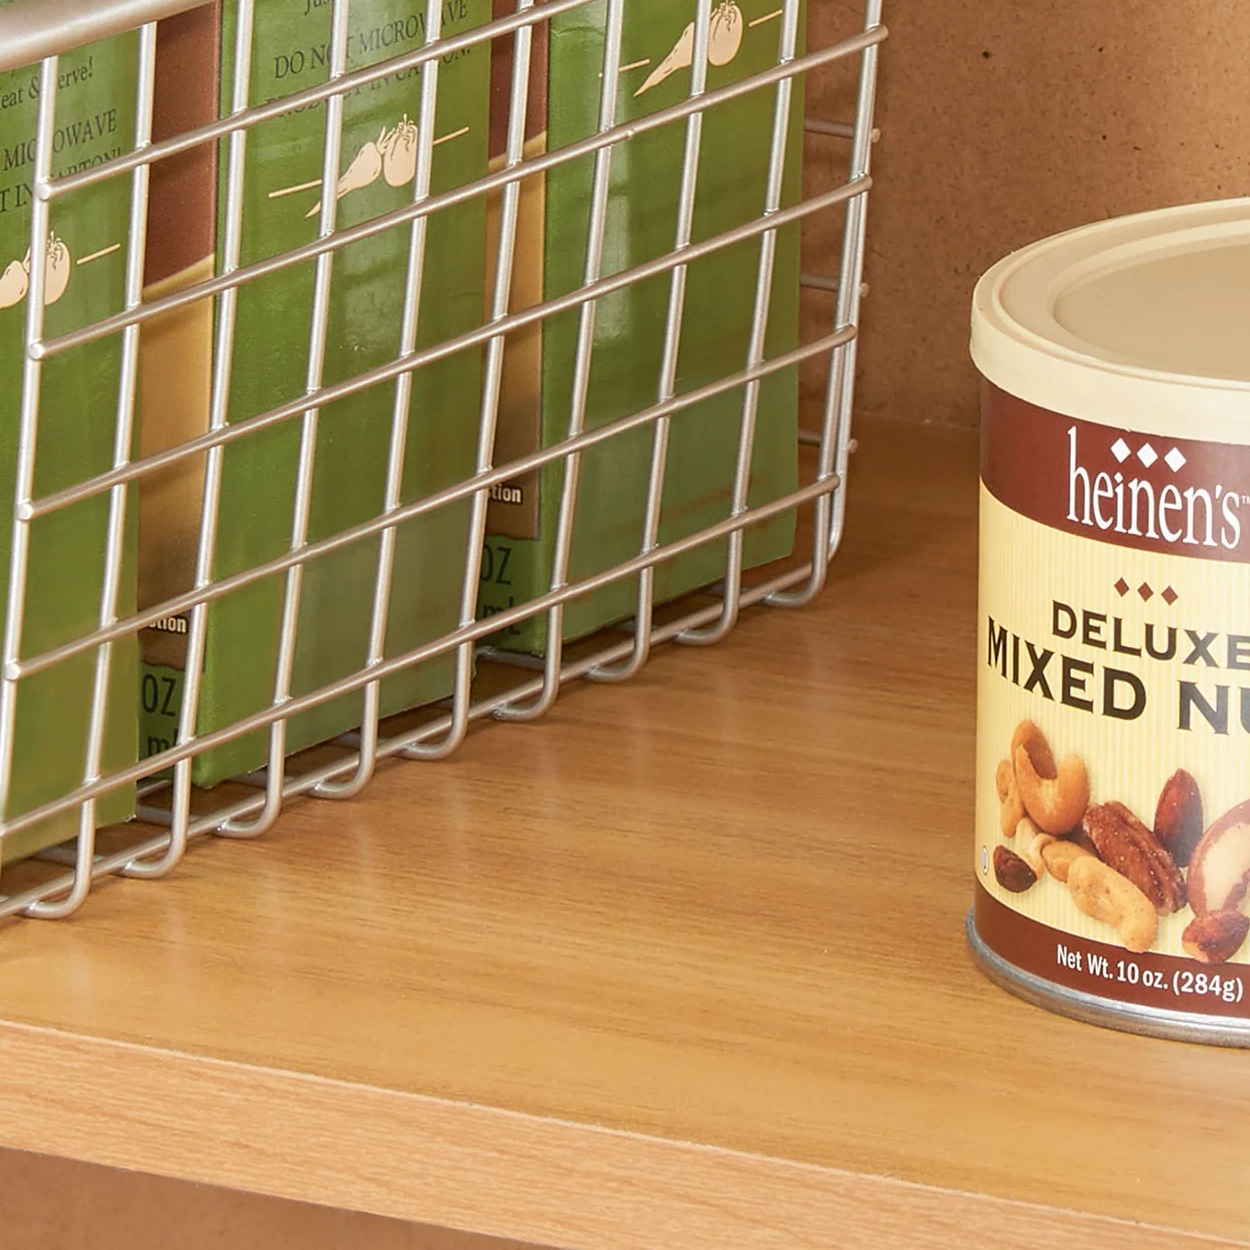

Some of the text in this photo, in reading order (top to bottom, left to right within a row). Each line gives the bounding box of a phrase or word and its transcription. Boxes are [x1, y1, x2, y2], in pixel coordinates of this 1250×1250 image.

[56, 55, 93, 90] erve!
[274, 50, 305, 79] DO
[3, 108, 118, 170] MICOWAVE
[1066, 425, 1241, 549] heinen's
[1052, 600, 1250, 671] DELUXE
[141, 673, 177, 717] OZ
[987, 615, 1146, 720] MIXED
[1056, 943, 1243, 1002] Net Wt. 10 oz. (284g)
